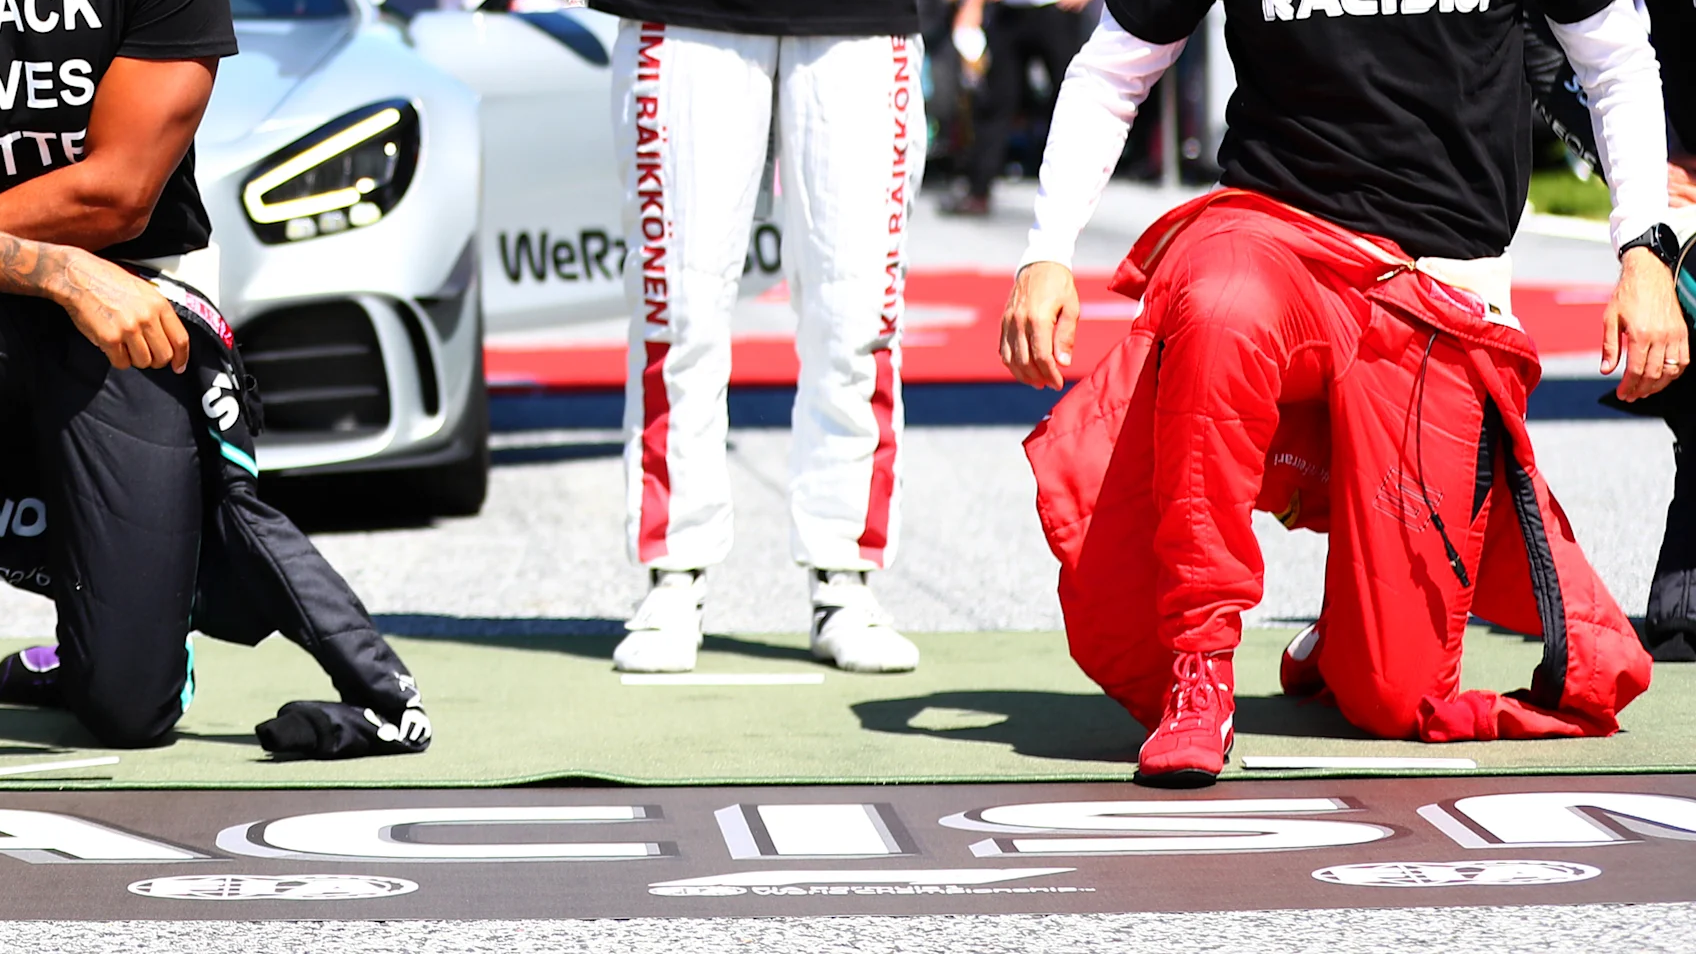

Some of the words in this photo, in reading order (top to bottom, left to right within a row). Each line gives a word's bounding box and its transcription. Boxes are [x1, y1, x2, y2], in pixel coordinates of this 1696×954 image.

[638, 21, 667, 82] IMI
[886, 34, 910, 234] RÄIKKÖNE
[635, 96, 674, 327] RÄIKKÖNEN
[879, 248, 901, 337] KIMI
